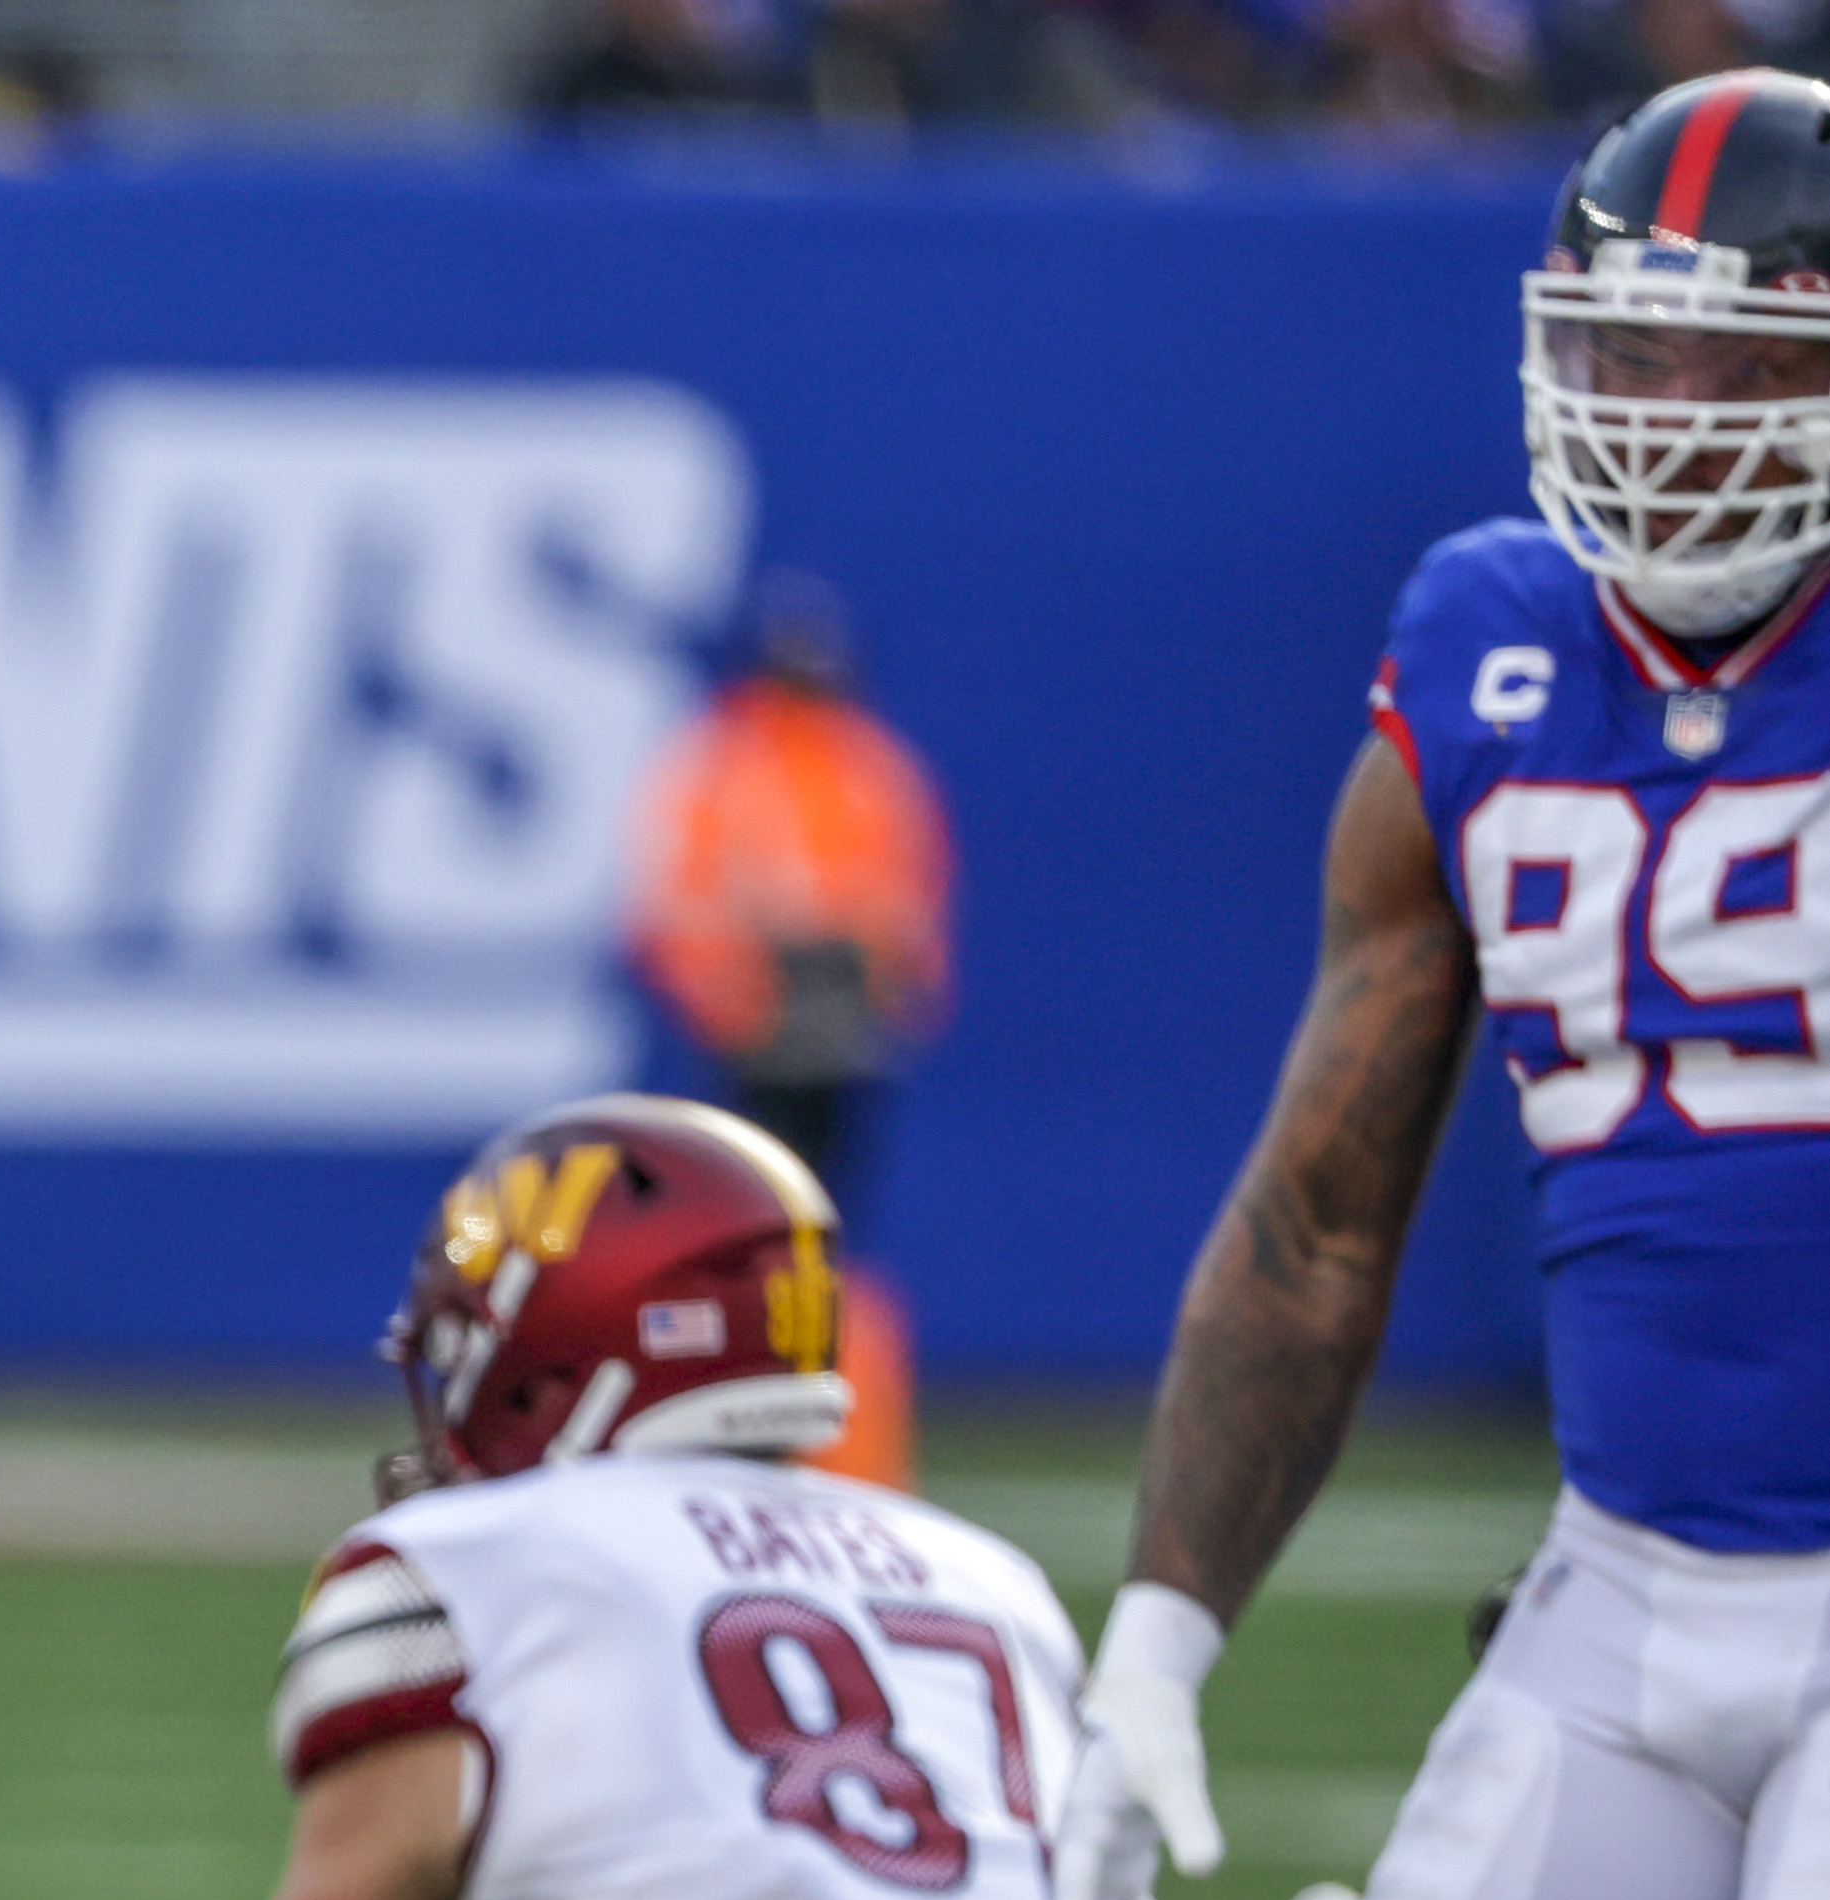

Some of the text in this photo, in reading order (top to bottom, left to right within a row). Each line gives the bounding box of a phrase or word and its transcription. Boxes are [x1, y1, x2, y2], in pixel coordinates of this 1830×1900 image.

[1457, 777, 1830, 1154] 99
[683, 1494, 931, 1592] BATES
[695, 1590, 1056, 1893] 87
